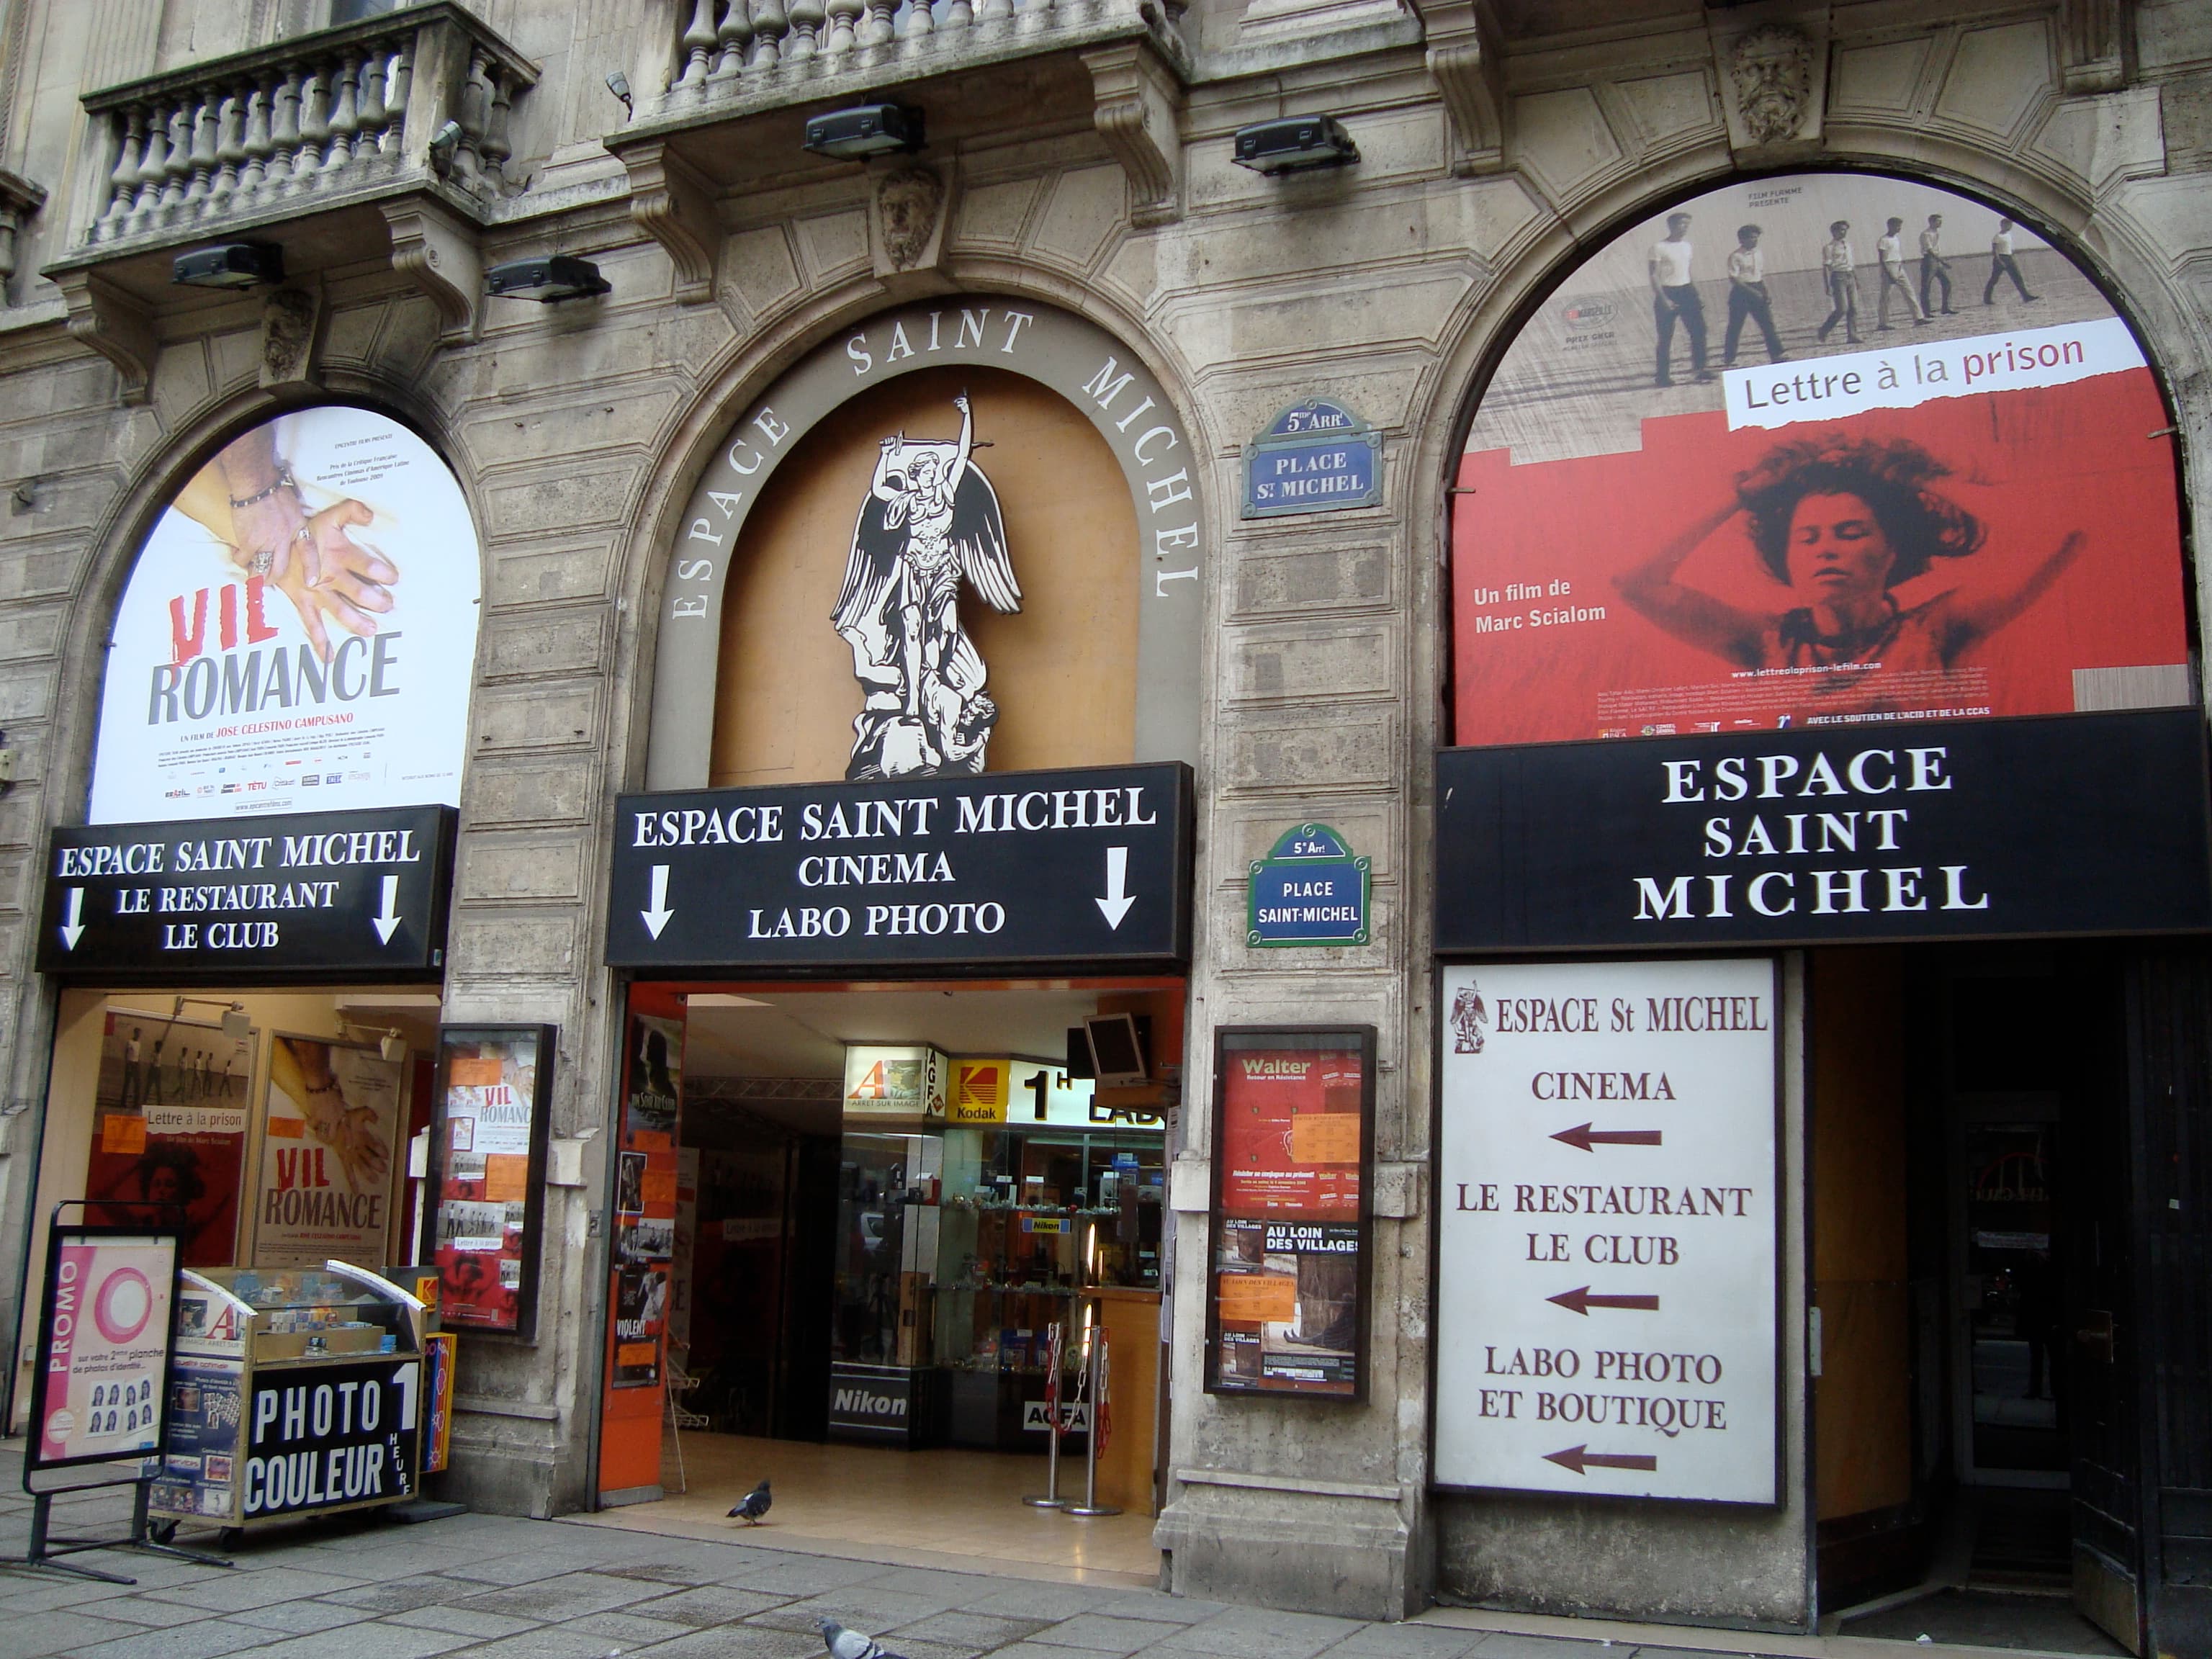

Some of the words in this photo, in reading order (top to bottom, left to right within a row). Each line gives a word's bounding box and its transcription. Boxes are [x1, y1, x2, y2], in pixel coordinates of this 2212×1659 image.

[1748, 192, 1768, 200] FILM
[1770, 186, 1803, 197] FLAMME
[1749, 197, 1790, 208] PRESENTE
[1745, 372, 1862, 409] Lettre
[1877, 360, 1899, 390] à
[1914, 355, 1948, 385] la
[1963, 340, 2085, 385] prison
[672, 406, 790, 621] ESPACE
[847, 308, 1034, 376] SAINT
[1082, 356, 1199, 598] MICHEL
[1275, 451, 1347, 475] PLACE
[1281, 474, 1364, 498] MICHEL
[1474, 587, 1500, 606] Un
[1506, 583, 1542, 601] film
[1548, 578, 1571, 596] de
[169, 575, 279, 668] VIL
[1475, 615, 1523, 634] Marc
[1529, 605, 1606, 627] Scialom
[148, 631, 403, 726] ROMANCE
[190, 732, 204, 741] FILM
[240, 719, 292, 735] CELESTINO
[295, 712, 354, 729] CAMPUSANO
[1807, 716, 1830, 725] AVEC
[1832, 714, 1843, 723] LE
[1844, 712, 1882, 723] SOUTIEN
[1883, 711, 1896, 721] DE
[1897, 710, 1925, 719] L'ACID
[1926, 709, 1938, 719] ET
[1938, 709, 1952, 717] DE
[1952, 708, 1966, 716] LA
[1966, 706, 1991, 716] CCAS
[1660, 747, 1953, 804] ESPACE
[633, 806, 783, 848] ESPACE
[801, 797, 939, 842] SAINT
[954, 787, 1158, 835] MICHEL
[1704, 808, 1908, 858] SAINT
[58, 842, 166, 878] ESPACE
[175, 836, 272, 873] SAINT
[281, 830, 421, 868] MICHEL
[798, 850, 956, 888] CINEMA
[117, 889, 151, 914] LE
[158, 881, 340, 912] RESTAURANT
[1282, 881, 1334, 897] PLACE
[1632, 865, 1989, 921] MICHEL
[747, 904, 851, 939] LABO
[864, 901, 1006, 937] PHOTO
[1258, 906, 1359, 923] SAINT-MICHEL
[164, 924, 199, 950] LE
[207, 921, 279, 949] CLUB
[1496, 997, 1600, 1033] ESPACE
[1611, 997, 1635, 1033] St
[1647, 996, 1768, 1033] MICHEL
[1242, 1059, 1312, 1074] Walter
[485, 1086, 512, 1107] VIL
[926, 1050, 937, 1118] AGFA
[1532, 1071, 1677, 1100] CINEMA
[148, 1110, 184, 1125] Lettre
[186, 1111, 193, 1125] à
[197, 1111, 207, 1125] la
[210, 1112, 242, 1128] prison
[480, 1105, 531, 1125] ROMANC
[957, 1107, 997, 1120] Kodak
[276, 1147, 331, 1193] VIL
[264, 1188, 382, 1229] ROMANCE
[1456, 1183, 1500, 1211] LE
[1514, 1184, 1753, 1216] RESTAURANT
[1033, 1221, 1060, 1230] Nikon
[1266, 1226, 1289, 1238] AU
[1290, 1226, 1323, 1238] LOIN
[1266, 1238, 1293, 1250] DES
[1526, 1233, 1570, 1262] LE
[1584, 1233, 1680, 1265] CLUB
[49, 1260, 78, 1373] PROMO
[616, 1318, 647, 1336] VIOLENT
[129, 1347, 164, 1362] planche
[1484, 1346, 1581, 1378] LABO
[1594, 1350, 1723, 1385] PHOTO
[84, 1364, 108, 1375] photos
[255, 1380, 381, 1444] PHOTO
[392, 1362, 419, 1430] 1
[834, 1388, 907, 1416] Nikon
[1478, 1388, 1523, 1419] ET
[1536, 1391, 1727, 1438] BOUTIQUE
[244, 1443, 385, 1513] COULEUR
